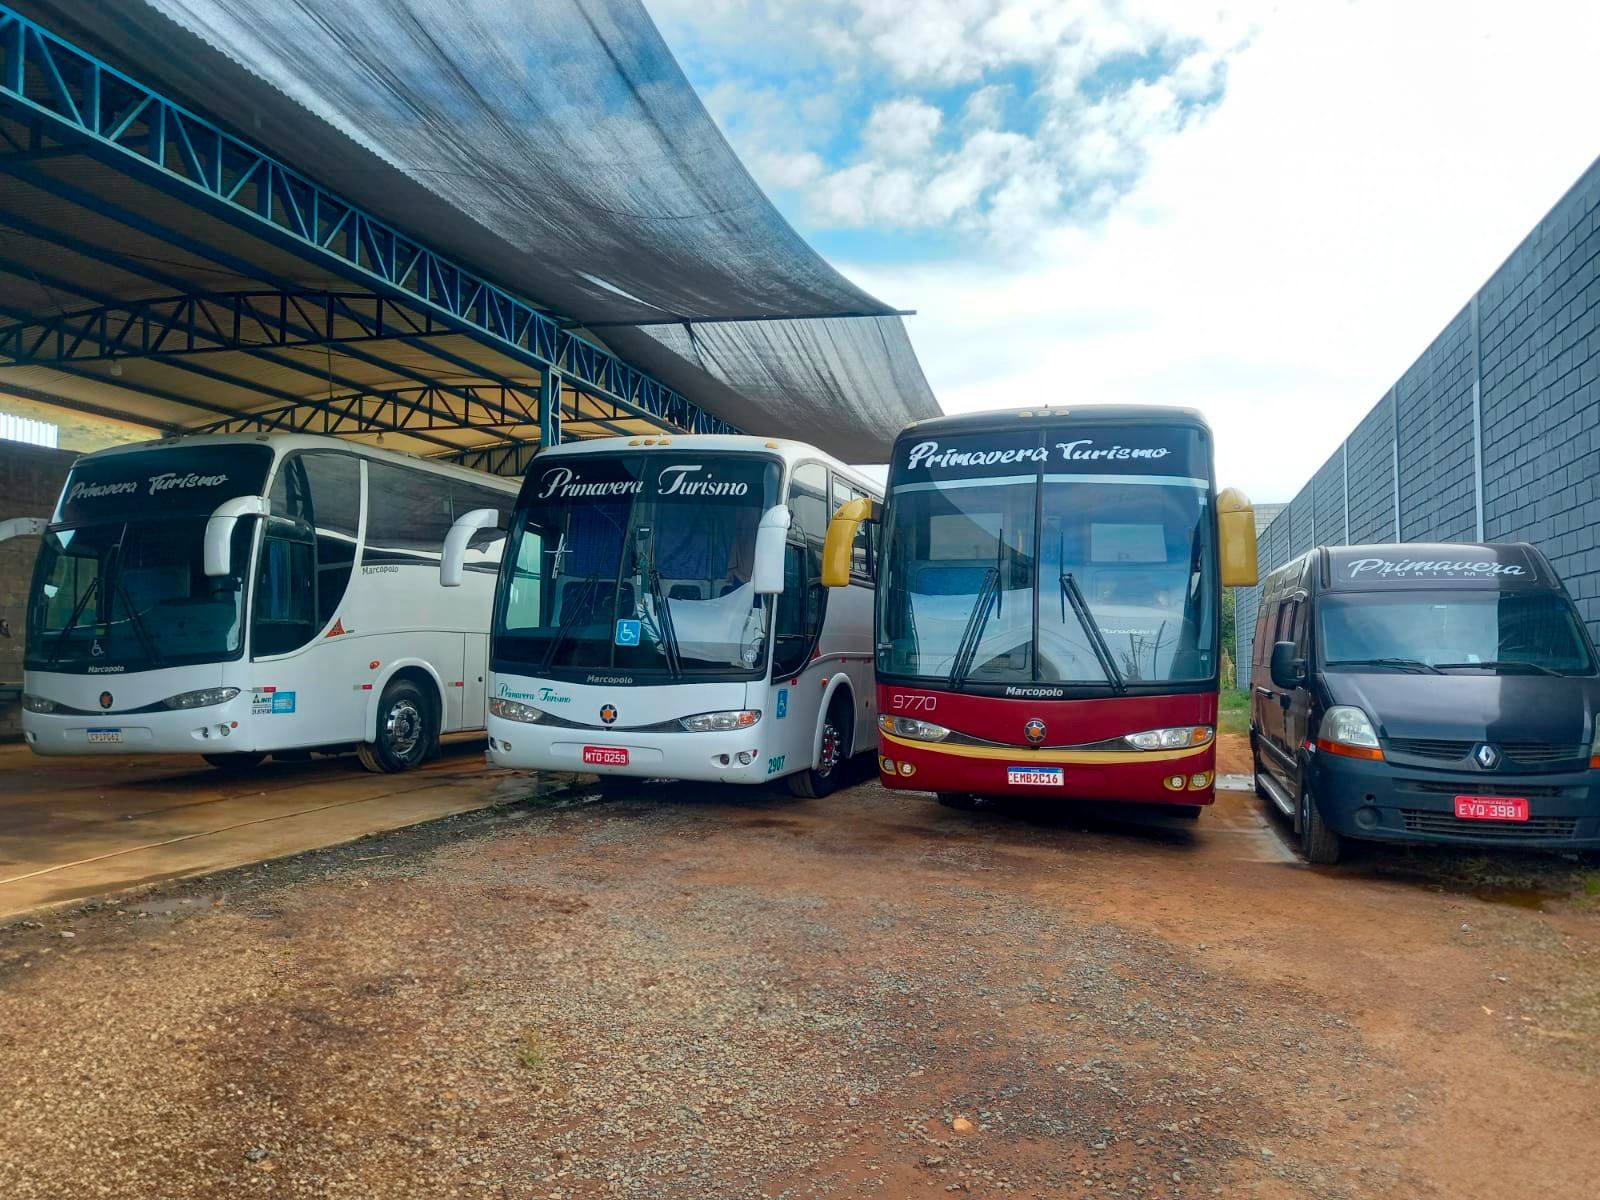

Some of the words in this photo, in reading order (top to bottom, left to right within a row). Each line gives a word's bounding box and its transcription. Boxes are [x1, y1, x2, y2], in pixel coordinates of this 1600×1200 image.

[908, 441, 1048, 470] Primavera
[1055, 440, 1171, 461] Turismo
[66, 482, 138, 504] Primavera
[149, 473, 229, 495] Turismo
[538, 467, 644, 499] Primavera
[658, 465, 748, 496] Turismo
[362, 566, 399, 575] Marcopolo
[1348, 558, 1526, 578] Primavera
[88, 665, 125, 673] Marcopolo
[586, 674, 633, 684] Marcopolo
[498, 682, 534, 700] Primavera
[538, 687, 571, 703] Turismo
[1005, 686, 1063, 697] Marcopolo
[893, 694, 937, 711] 9770
[768, 755, 785, 774] 2907
[1013, 773, 1058, 784] EMB2C16
